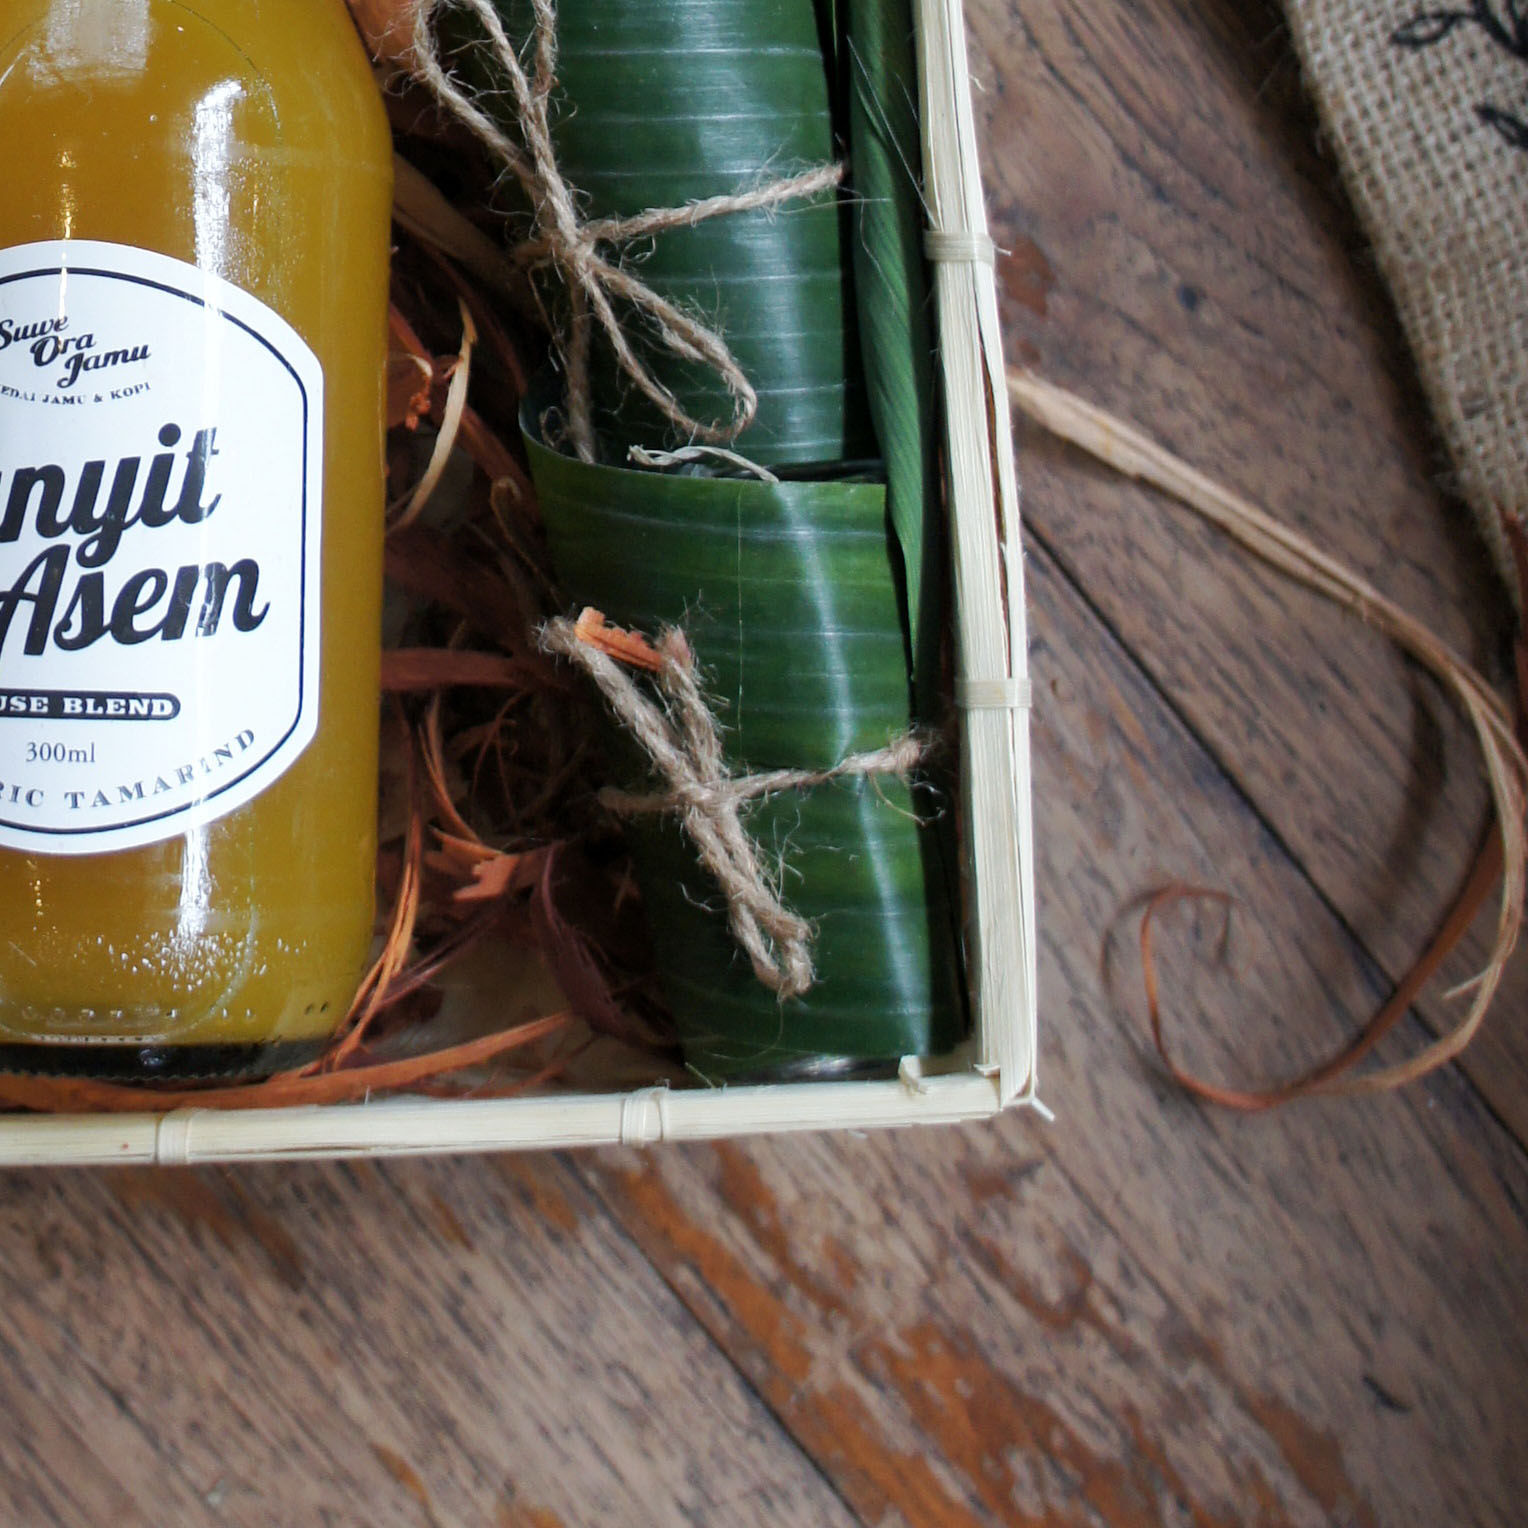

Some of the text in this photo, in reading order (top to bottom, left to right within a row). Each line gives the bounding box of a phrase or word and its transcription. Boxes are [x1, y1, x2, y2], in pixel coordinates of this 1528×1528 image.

[30, 333, 96, 367] Ora
[57, 345, 151, 388] Jamu
[42, 394, 86, 405] JAMU
[93, 393, 103, 403] &
[110, 382, 151, 400] KOPI
[63, 697, 173, 717] BLEND
[25, 742, 96, 764] 300ml
[65, 728, 256, 809] TAMARIND
